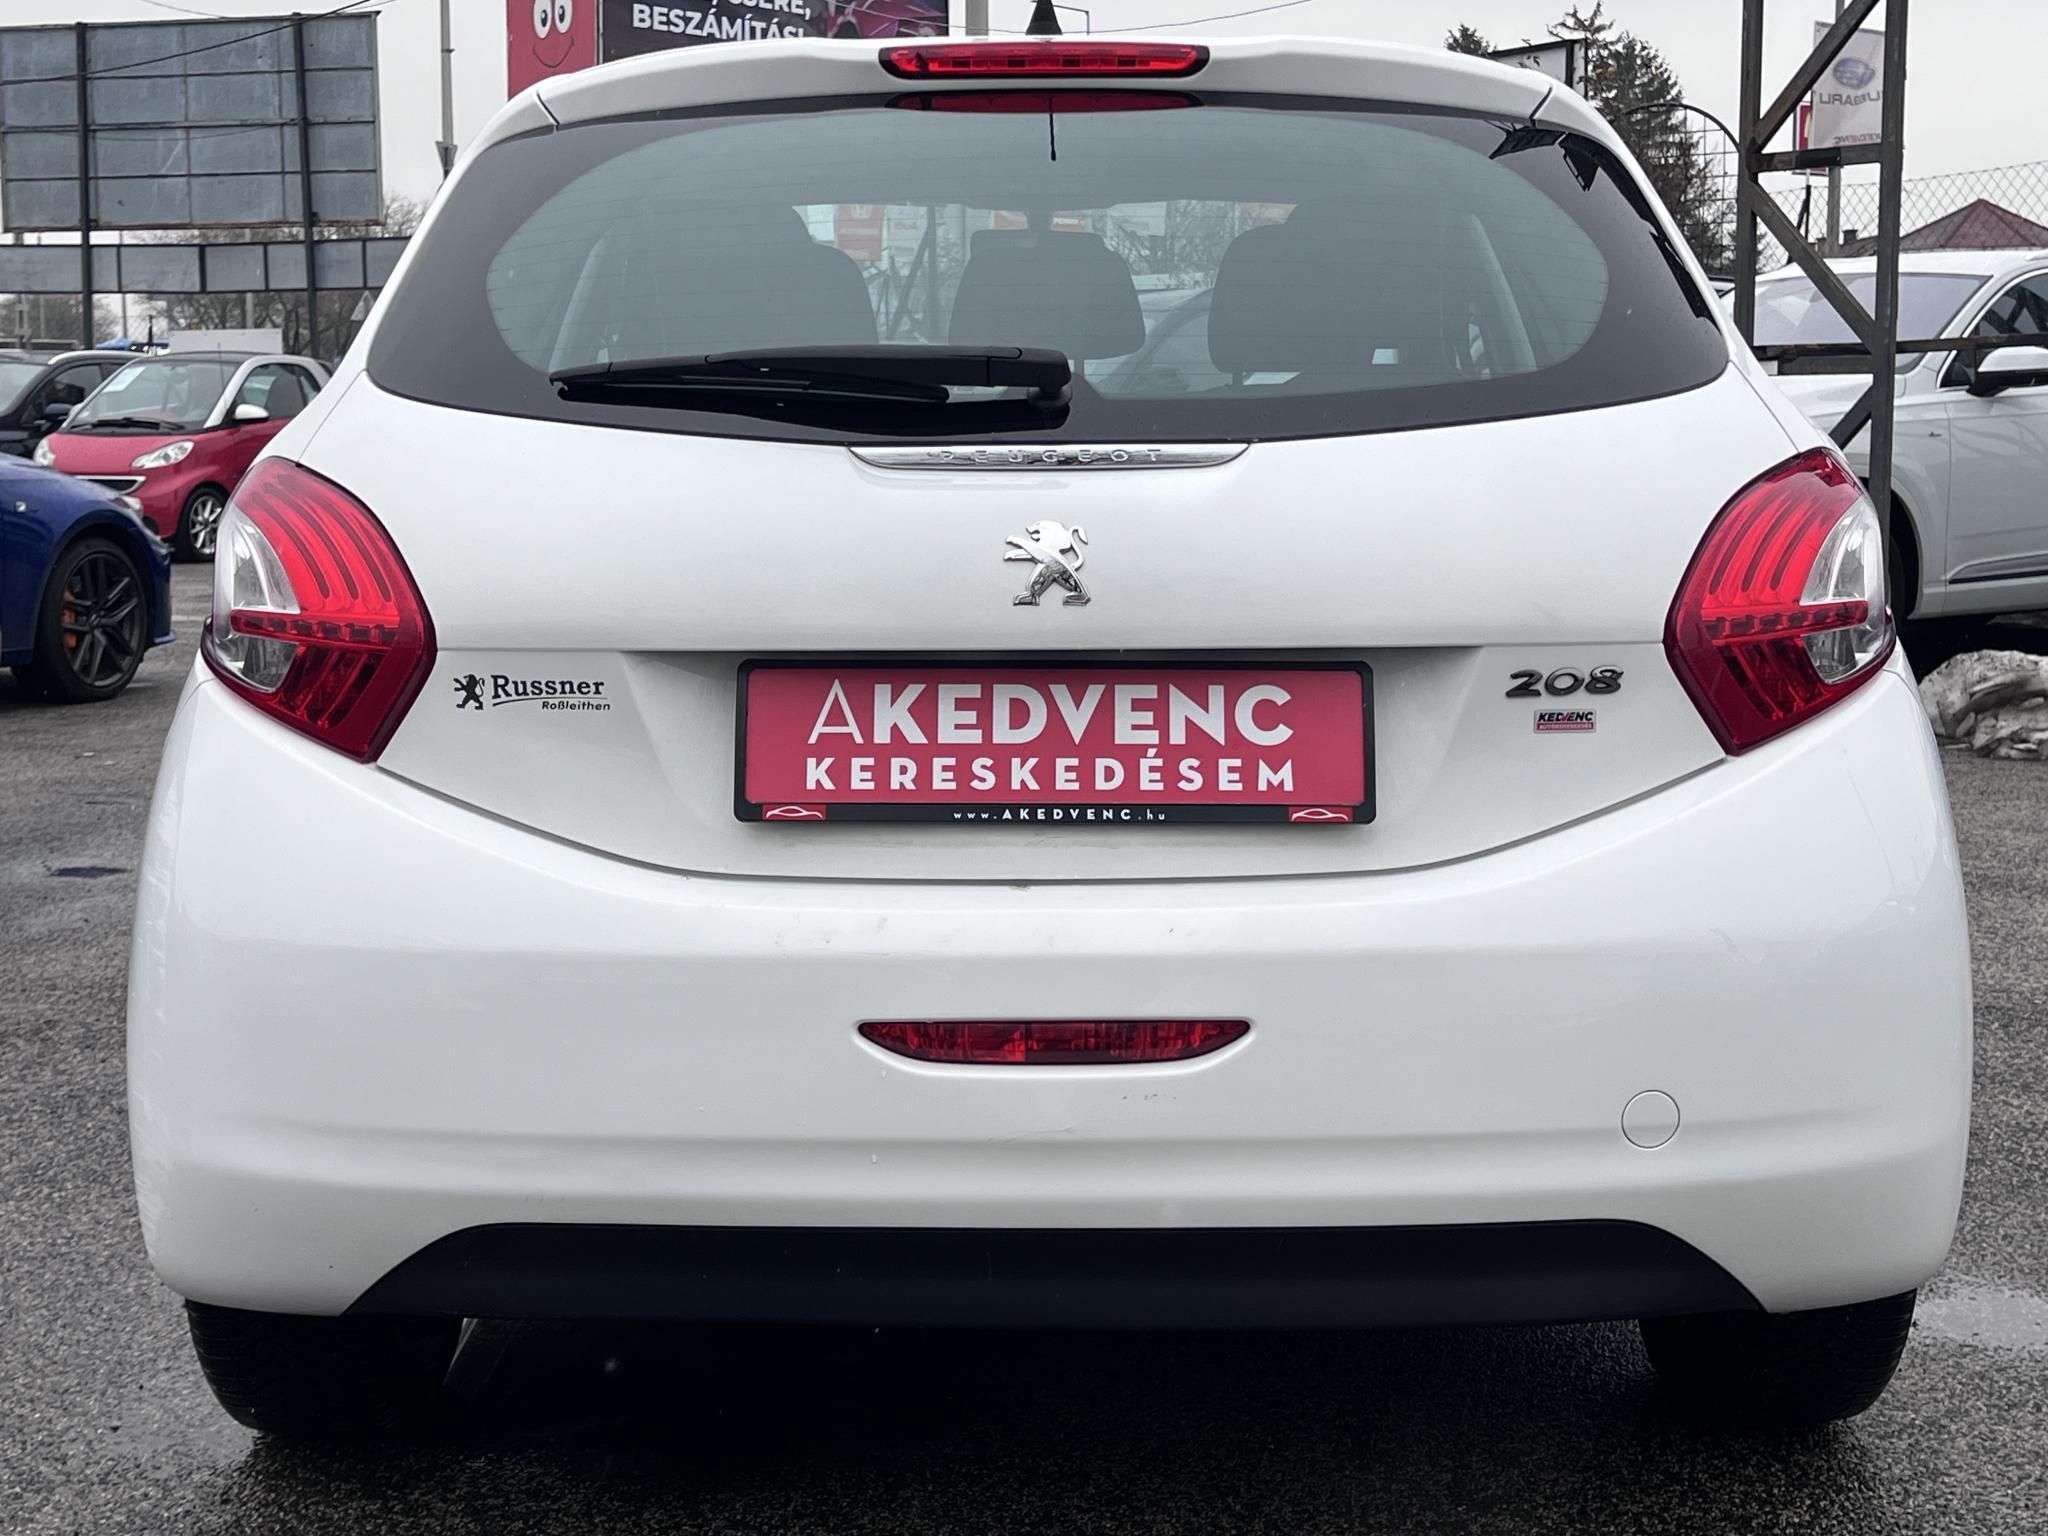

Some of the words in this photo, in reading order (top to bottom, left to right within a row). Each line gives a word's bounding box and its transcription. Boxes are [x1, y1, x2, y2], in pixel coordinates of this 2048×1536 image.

[940, 448, 1162, 462] PEUGEOT
[490, 674, 605, 700] Russner
[1505, 664, 1624, 698] 208
[541, 700, 611, 711] Roßleithen
[808, 678, 1294, 746] AKEDVENC
[806, 748, 1294, 792] KERESKEDÉSEM
[953, 808, 1166, 821] www.AKEDVENC.hu
